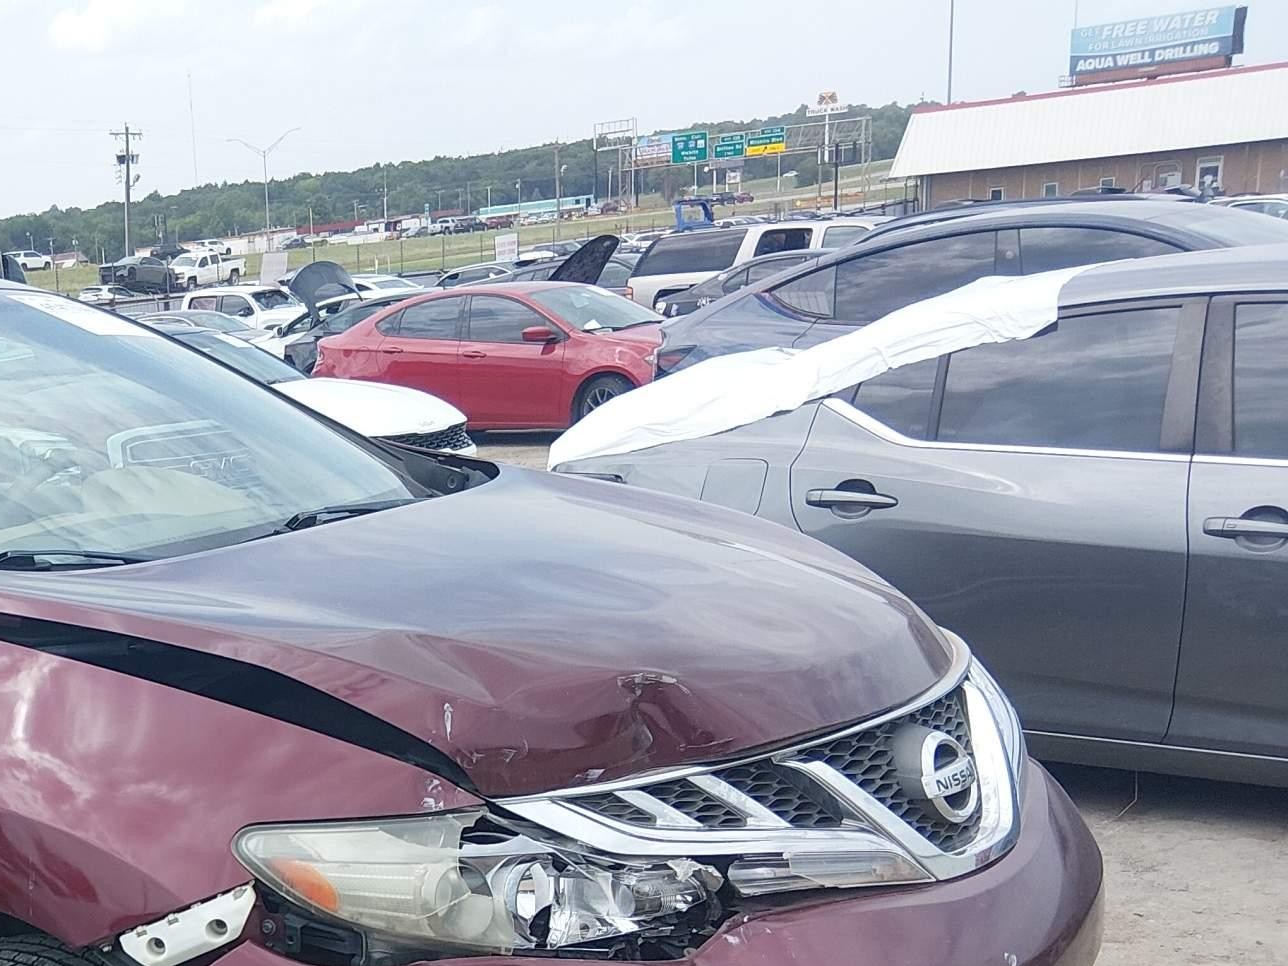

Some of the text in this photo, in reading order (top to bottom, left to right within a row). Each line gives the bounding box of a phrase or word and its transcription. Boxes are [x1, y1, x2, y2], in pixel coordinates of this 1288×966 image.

[1101, 20, 1148, 39] FREE
[1153, 10, 1220, 33] WATER
[1076, 42, 1220, 72] AQUA WELL DRILLING
[1088, 41, 1109, 52] FOR
